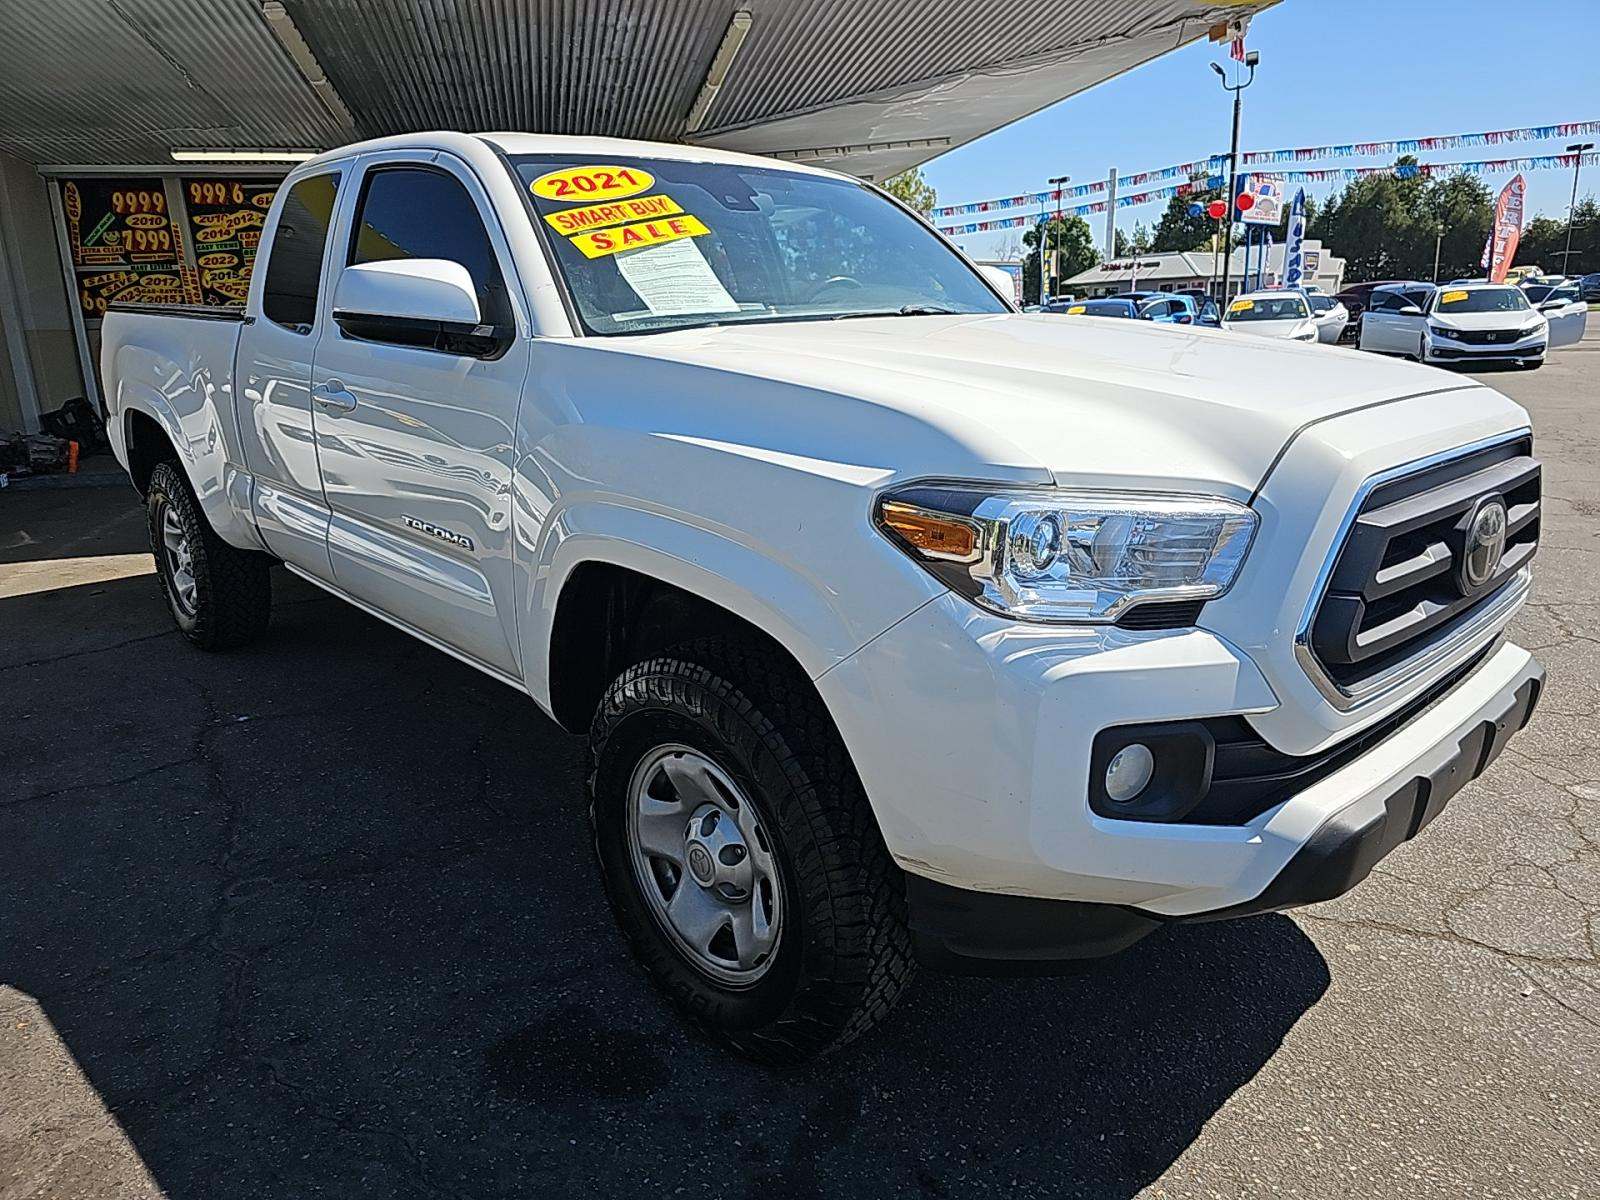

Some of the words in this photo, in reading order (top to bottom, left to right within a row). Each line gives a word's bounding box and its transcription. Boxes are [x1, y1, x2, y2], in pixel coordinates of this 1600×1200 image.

[547, 169, 640, 197] 2021
[112, 191, 165, 213] 9999
[132, 216, 163, 226] 2010
[227, 212, 254, 229] 2012
[555, 204, 625, 230] SMART
[631, 197, 669, 216] BUY
[122, 230, 170, 250] 7999
[590, 219, 687, 250] SALE
[203, 256, 235, 266] 2022
[88, 272, 121, 286] SALE
[105, 274, 134, 294] SAVE
[145, 276, 176, 287] 2017
[401, 513, 475, 553] TACOMA
